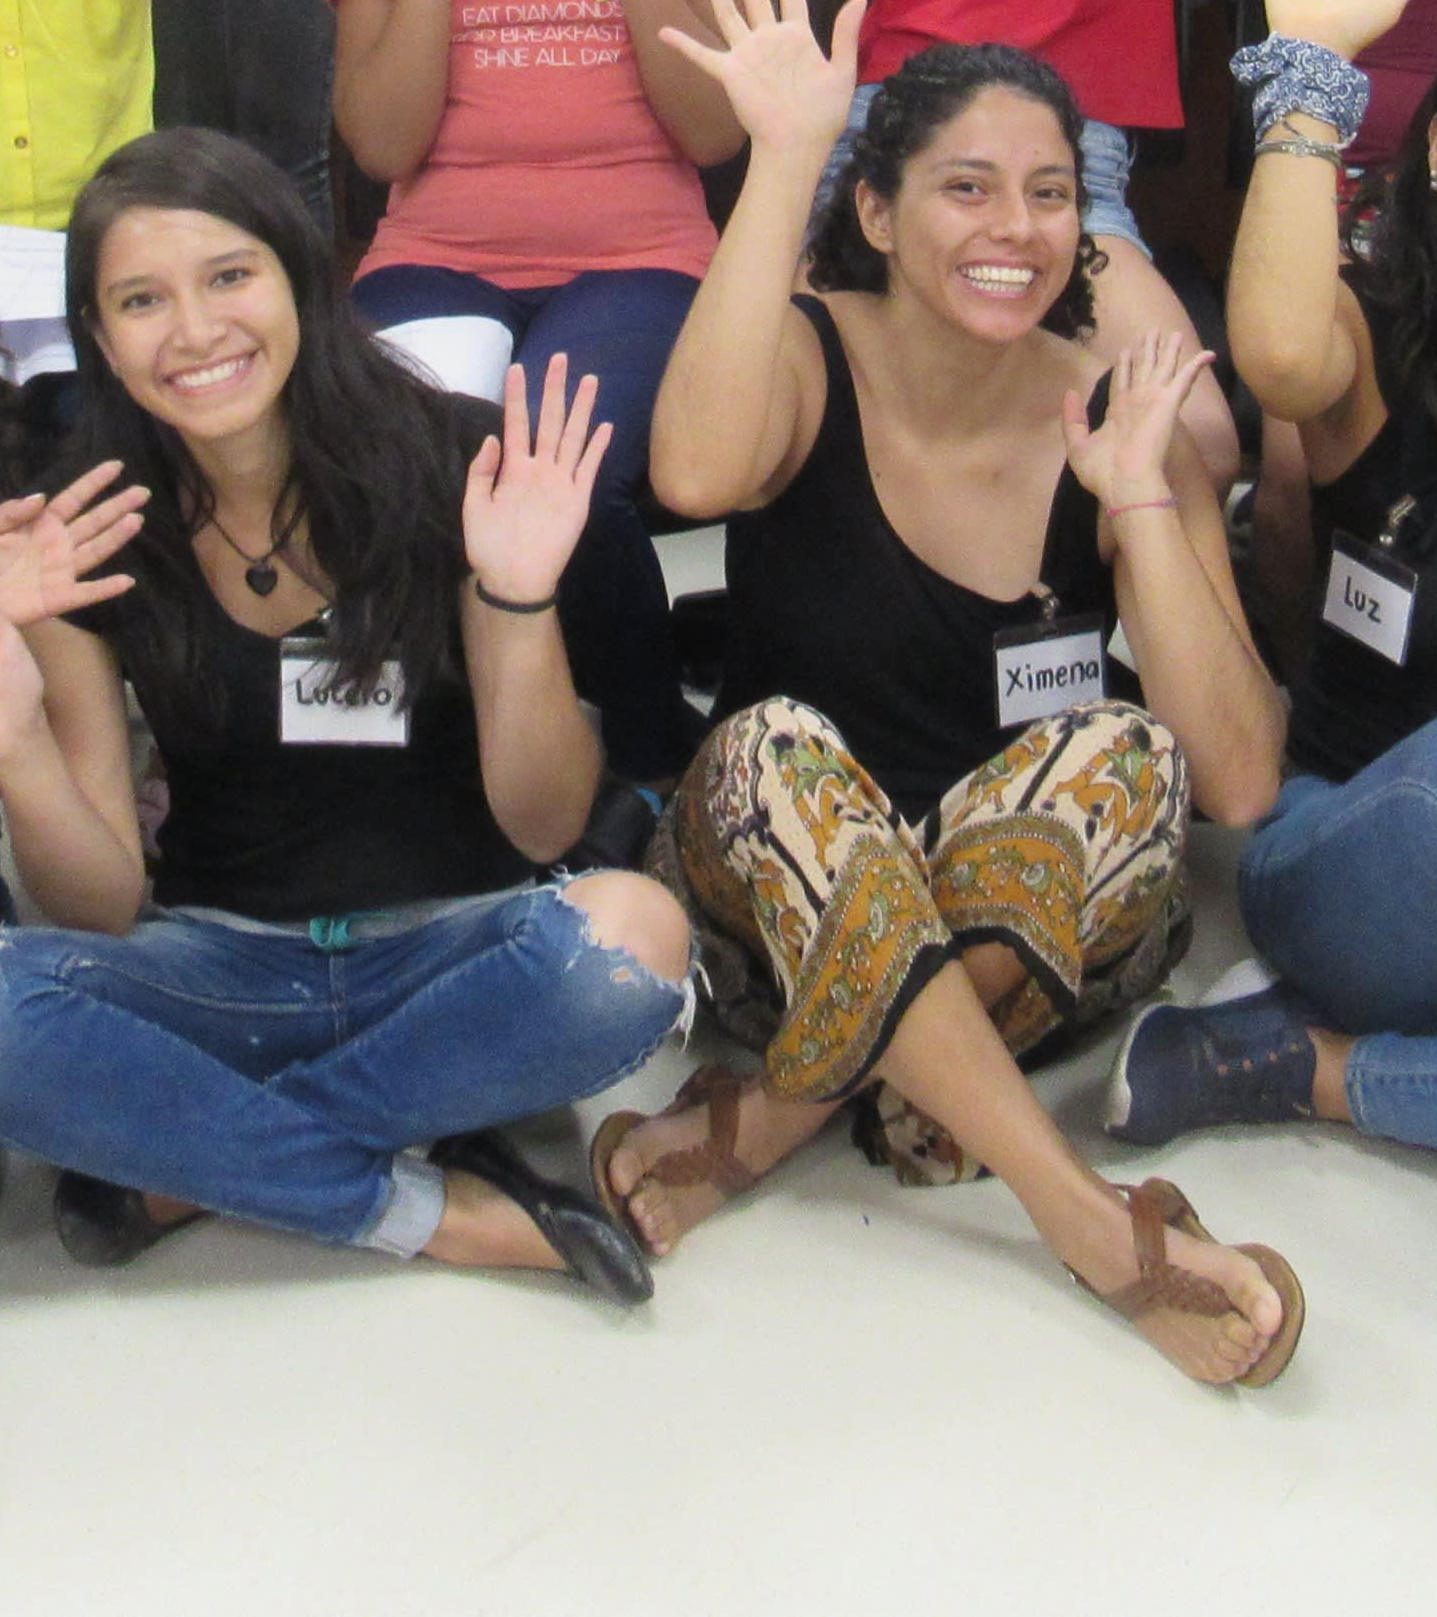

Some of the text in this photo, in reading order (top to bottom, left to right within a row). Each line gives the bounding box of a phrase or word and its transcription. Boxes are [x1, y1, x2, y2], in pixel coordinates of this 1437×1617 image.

[462, 0, 626, 27] EAT DIAMONDS
[500, 23, 622, 44] BREAKFAST
[474, 46, 622, 69] SHINE ALL DAY
[1006, 659, 1100, 697] Ximena
